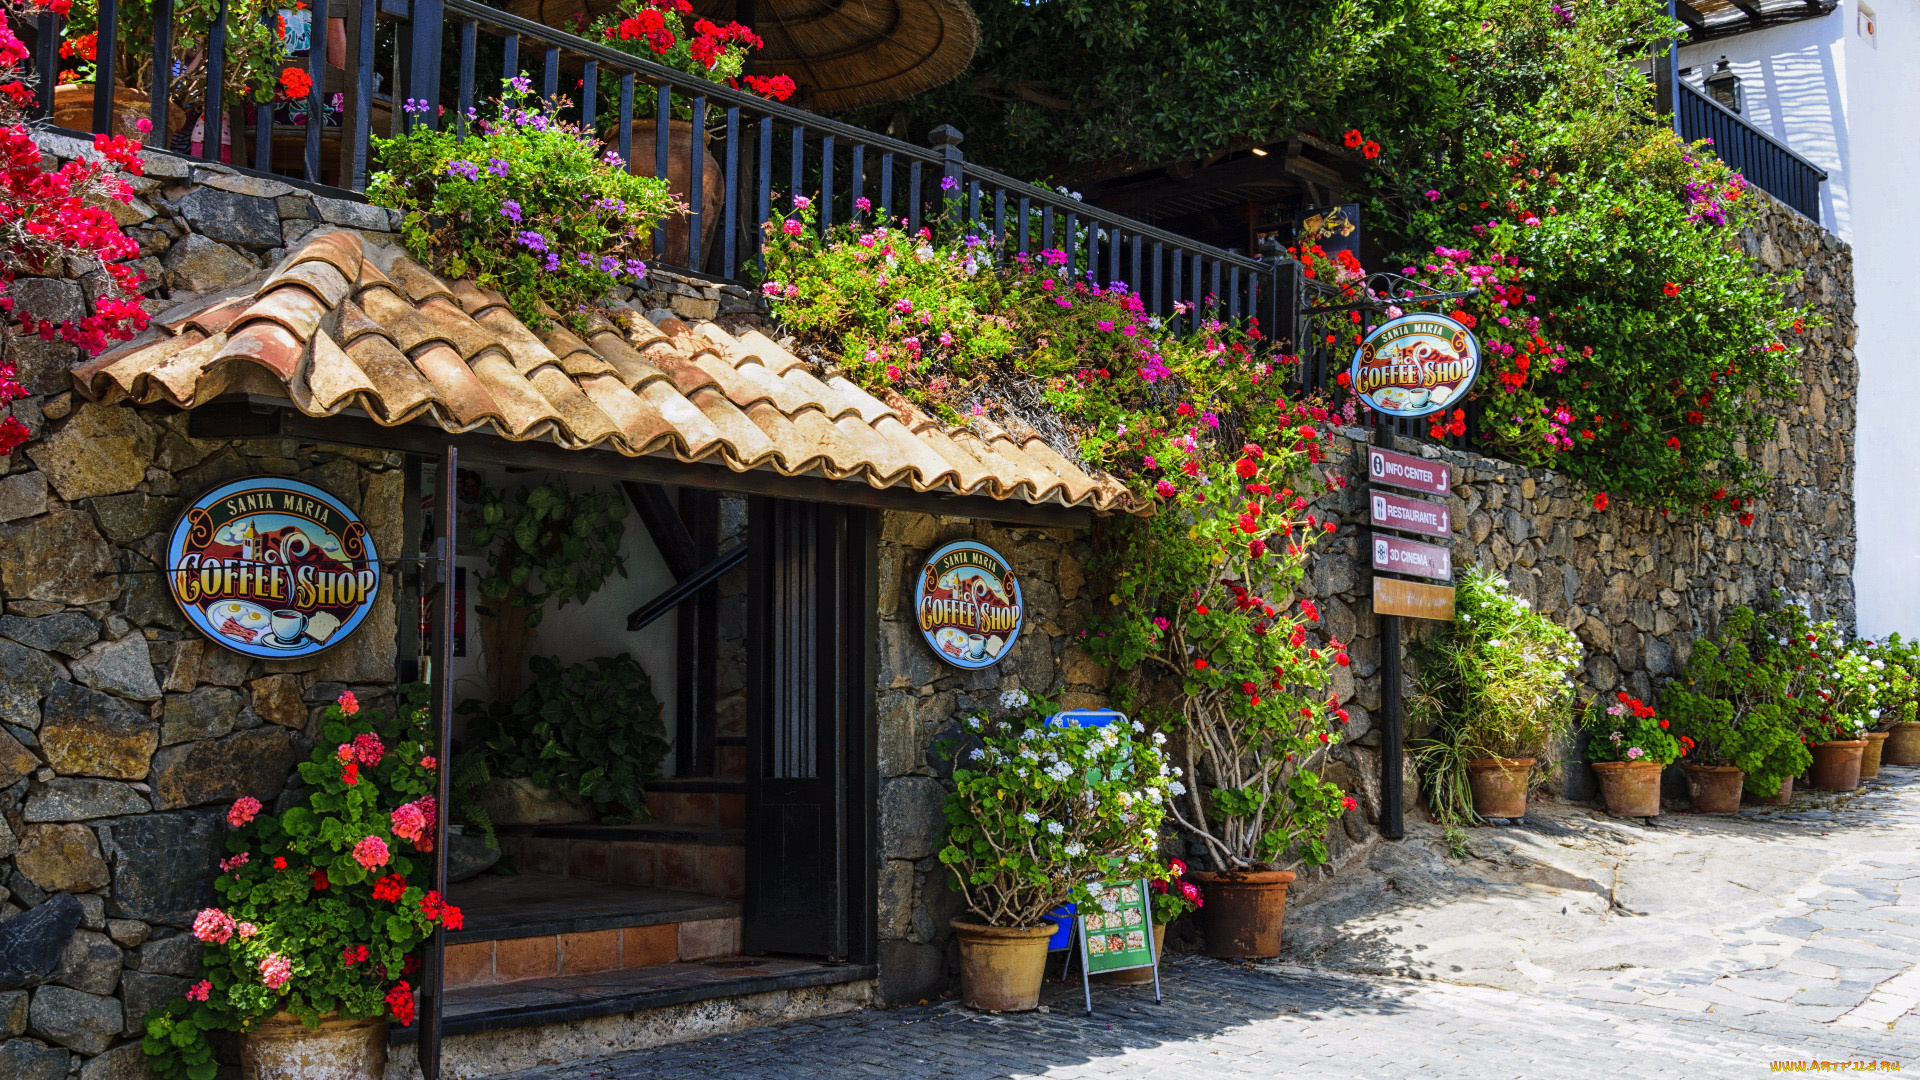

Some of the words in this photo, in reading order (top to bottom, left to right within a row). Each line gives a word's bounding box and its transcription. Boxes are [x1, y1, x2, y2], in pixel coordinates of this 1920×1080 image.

[1381, 326, 1409, 343] SANTA
[1414, 323, 1443, 336] MARIA
[1356, 366, 1418, 394] COFFEE
[1423, 356, 1475, 388] SHOP
[1385, 461, 1403, 477] INFO
[1404, 466, 1433, 483] CENTER
[226, 493, 274, 516] SANTA
[283, 494, 330, 524] MARIA
[1387, 504, 1438, 526] RESTAURANTE
[944, 552, 968, 569] SANTA
[972, 552, 997, 573] MARIA
[1389, 548, 1400, 561] 3D
[1401, 551, 1428, 567] CINEMA
[176, 553, 286, 603] COFFEE
[296, 564, 375, 609] SHOP
[920, 595, 976, 631] COFFEE
[981, 602, 1021, 633] SHOP
